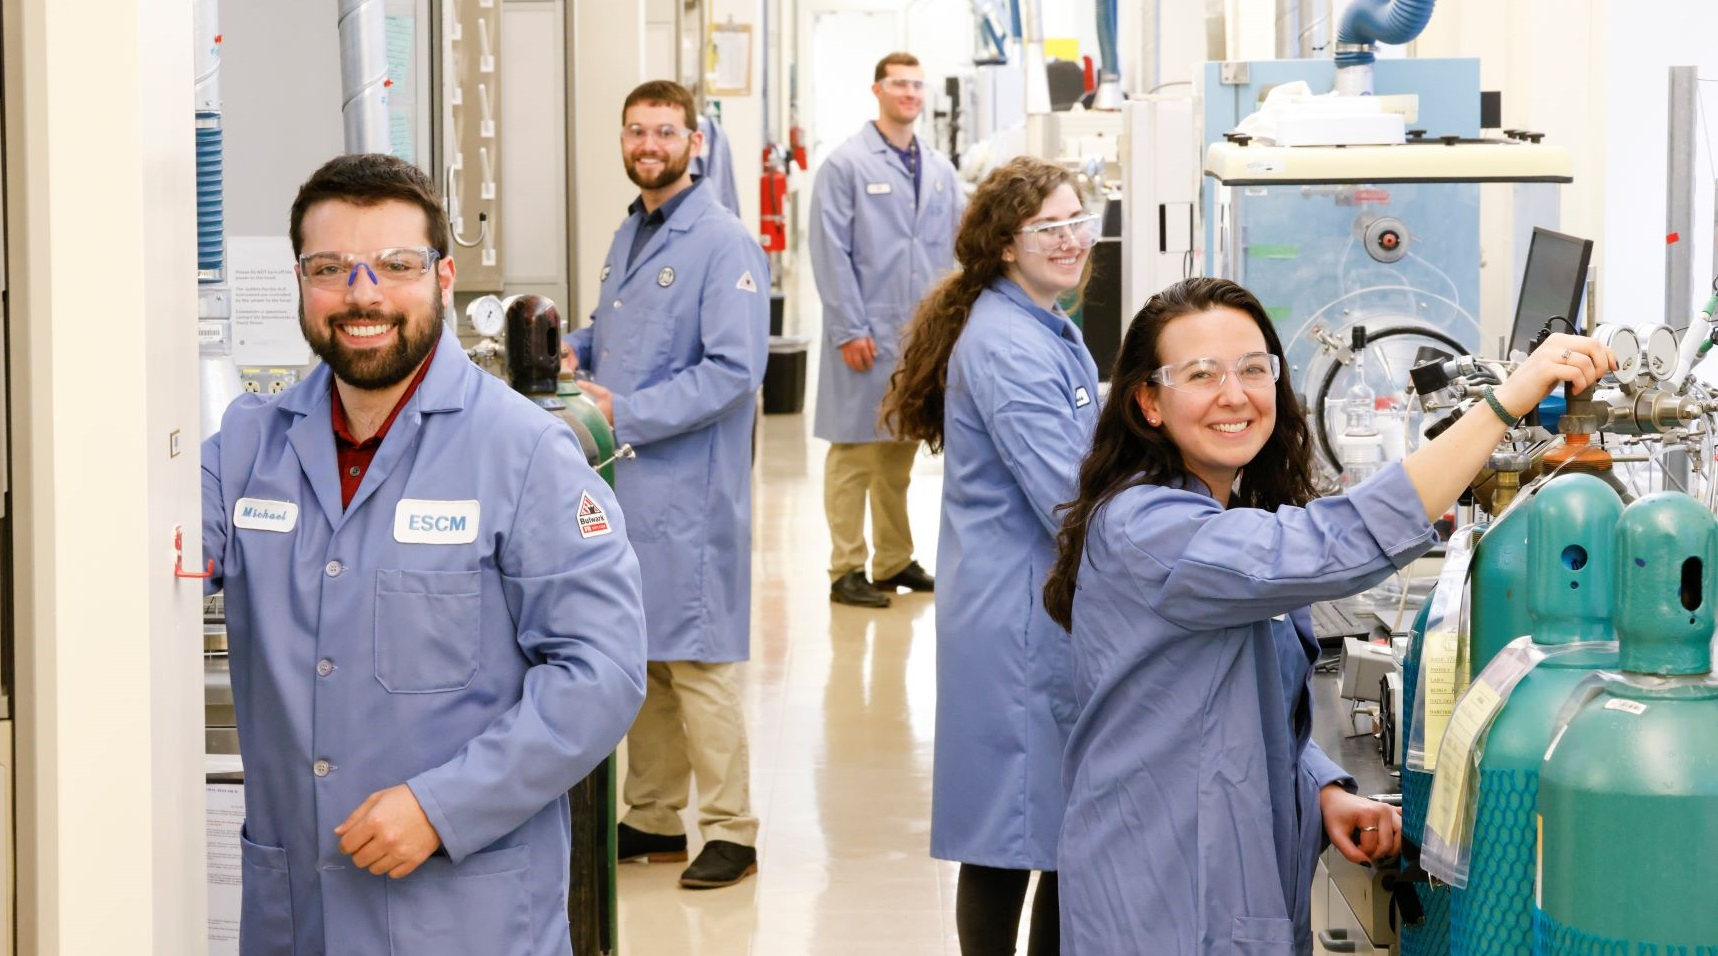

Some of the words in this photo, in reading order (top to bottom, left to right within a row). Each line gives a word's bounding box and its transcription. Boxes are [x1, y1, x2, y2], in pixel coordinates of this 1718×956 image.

[242, 506, 287, 521] Michael
[580, 515, 605, 524] Bulwark
[409, 514, 467, 531] ESCM
